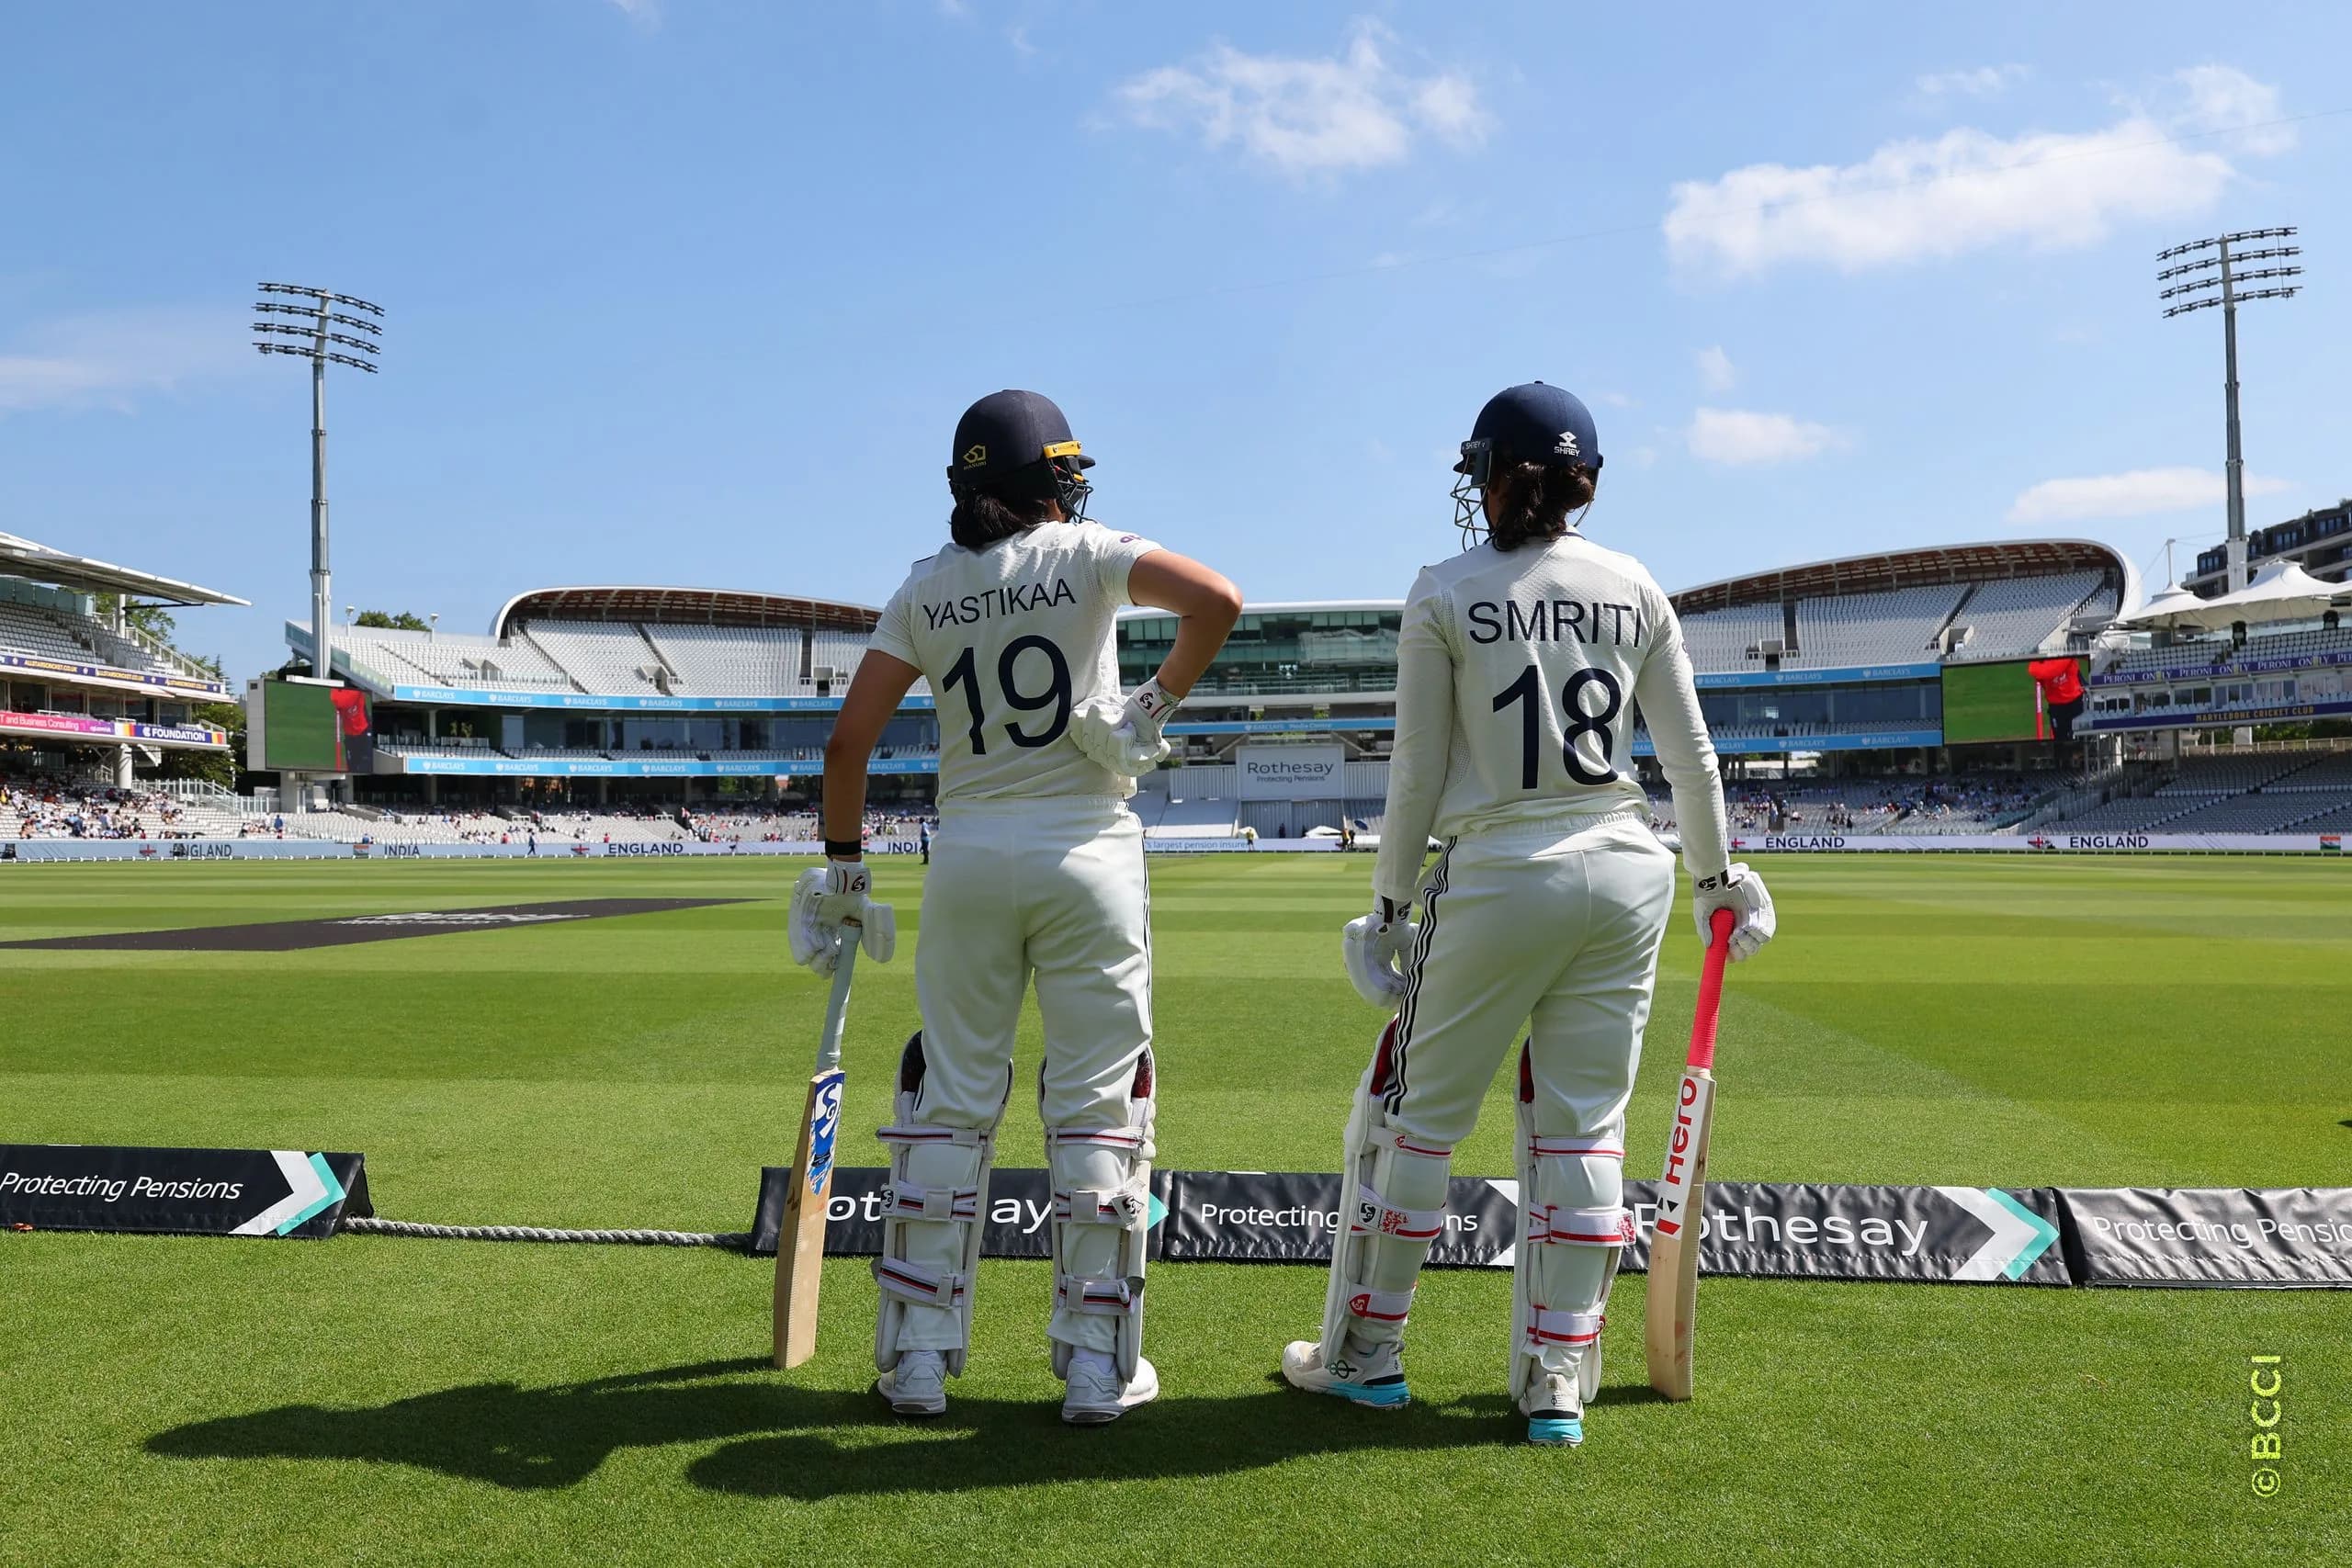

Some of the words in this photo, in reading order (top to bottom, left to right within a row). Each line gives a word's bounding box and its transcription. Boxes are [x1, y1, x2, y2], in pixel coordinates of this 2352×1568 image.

[1554, 446, 1580, 457] SHREY
[922, 578, 1077, 630] YASTIKAA
[1468, 600, 1641, 649] SMRITI
[1703, 675, 1741, 684] BARCLAYS
[1785, 671, 1823, 682] BARCLAYS
[1873, 668, 1911, 677] BARCLAYS
[2104, 673, 2135, 683] PERONI
[2179, 667, 2212, 677] PERONI
[2257, 660, 2291, 670] PERONI
[421, 691, 456, 700] BARCLAYS
[497, 694, 532, 704] BARCLAYS
[572, 697, 607, 705] BARCLAYS
[648, 699, 684, 707] BARCLAYS
[942, 635, 1072, 755] 19
[2254, 707, 2289, 717] CRICKET
[2292, 705, 2314, 715] CLUB
[19, 716, 47, 727] Business
[1492, 665, 1622, 790] 18
[152, 728, 206, 741] FOUNDATION
[1788, 739, 1826, 749] BARCLAYS
[1871, 736, 1911, 745] BARCLAYS
[431, 762, 466, 771] BARCLAYS
[504, 763, 539, 772] BARCLAYS
[1248, 761, 1334, 775] Rothesay
[608, 842, 684, 854] ENGLAND
[888, 841, 918, 852] INDI
[1153, 839, 1182, 850] largest
[1184, 839, 1218, 850] pension
[1765, 837, 1845, 848] ENGLAND
[2069, 836, 2149, 849] ENGLAND
[181, 843, 232, 857] NGLAND
[384, 845, 421, 856] INDIA
[1666, 1077, 1697, 1186] Hero
[0, 1172, 127, 1202] Protecting
[130, 1176, 243, 1200] Pensions
[1201, 1203, 1340, 1234] Protecting
[2093, 1217, 2254, 1249] Protecting
